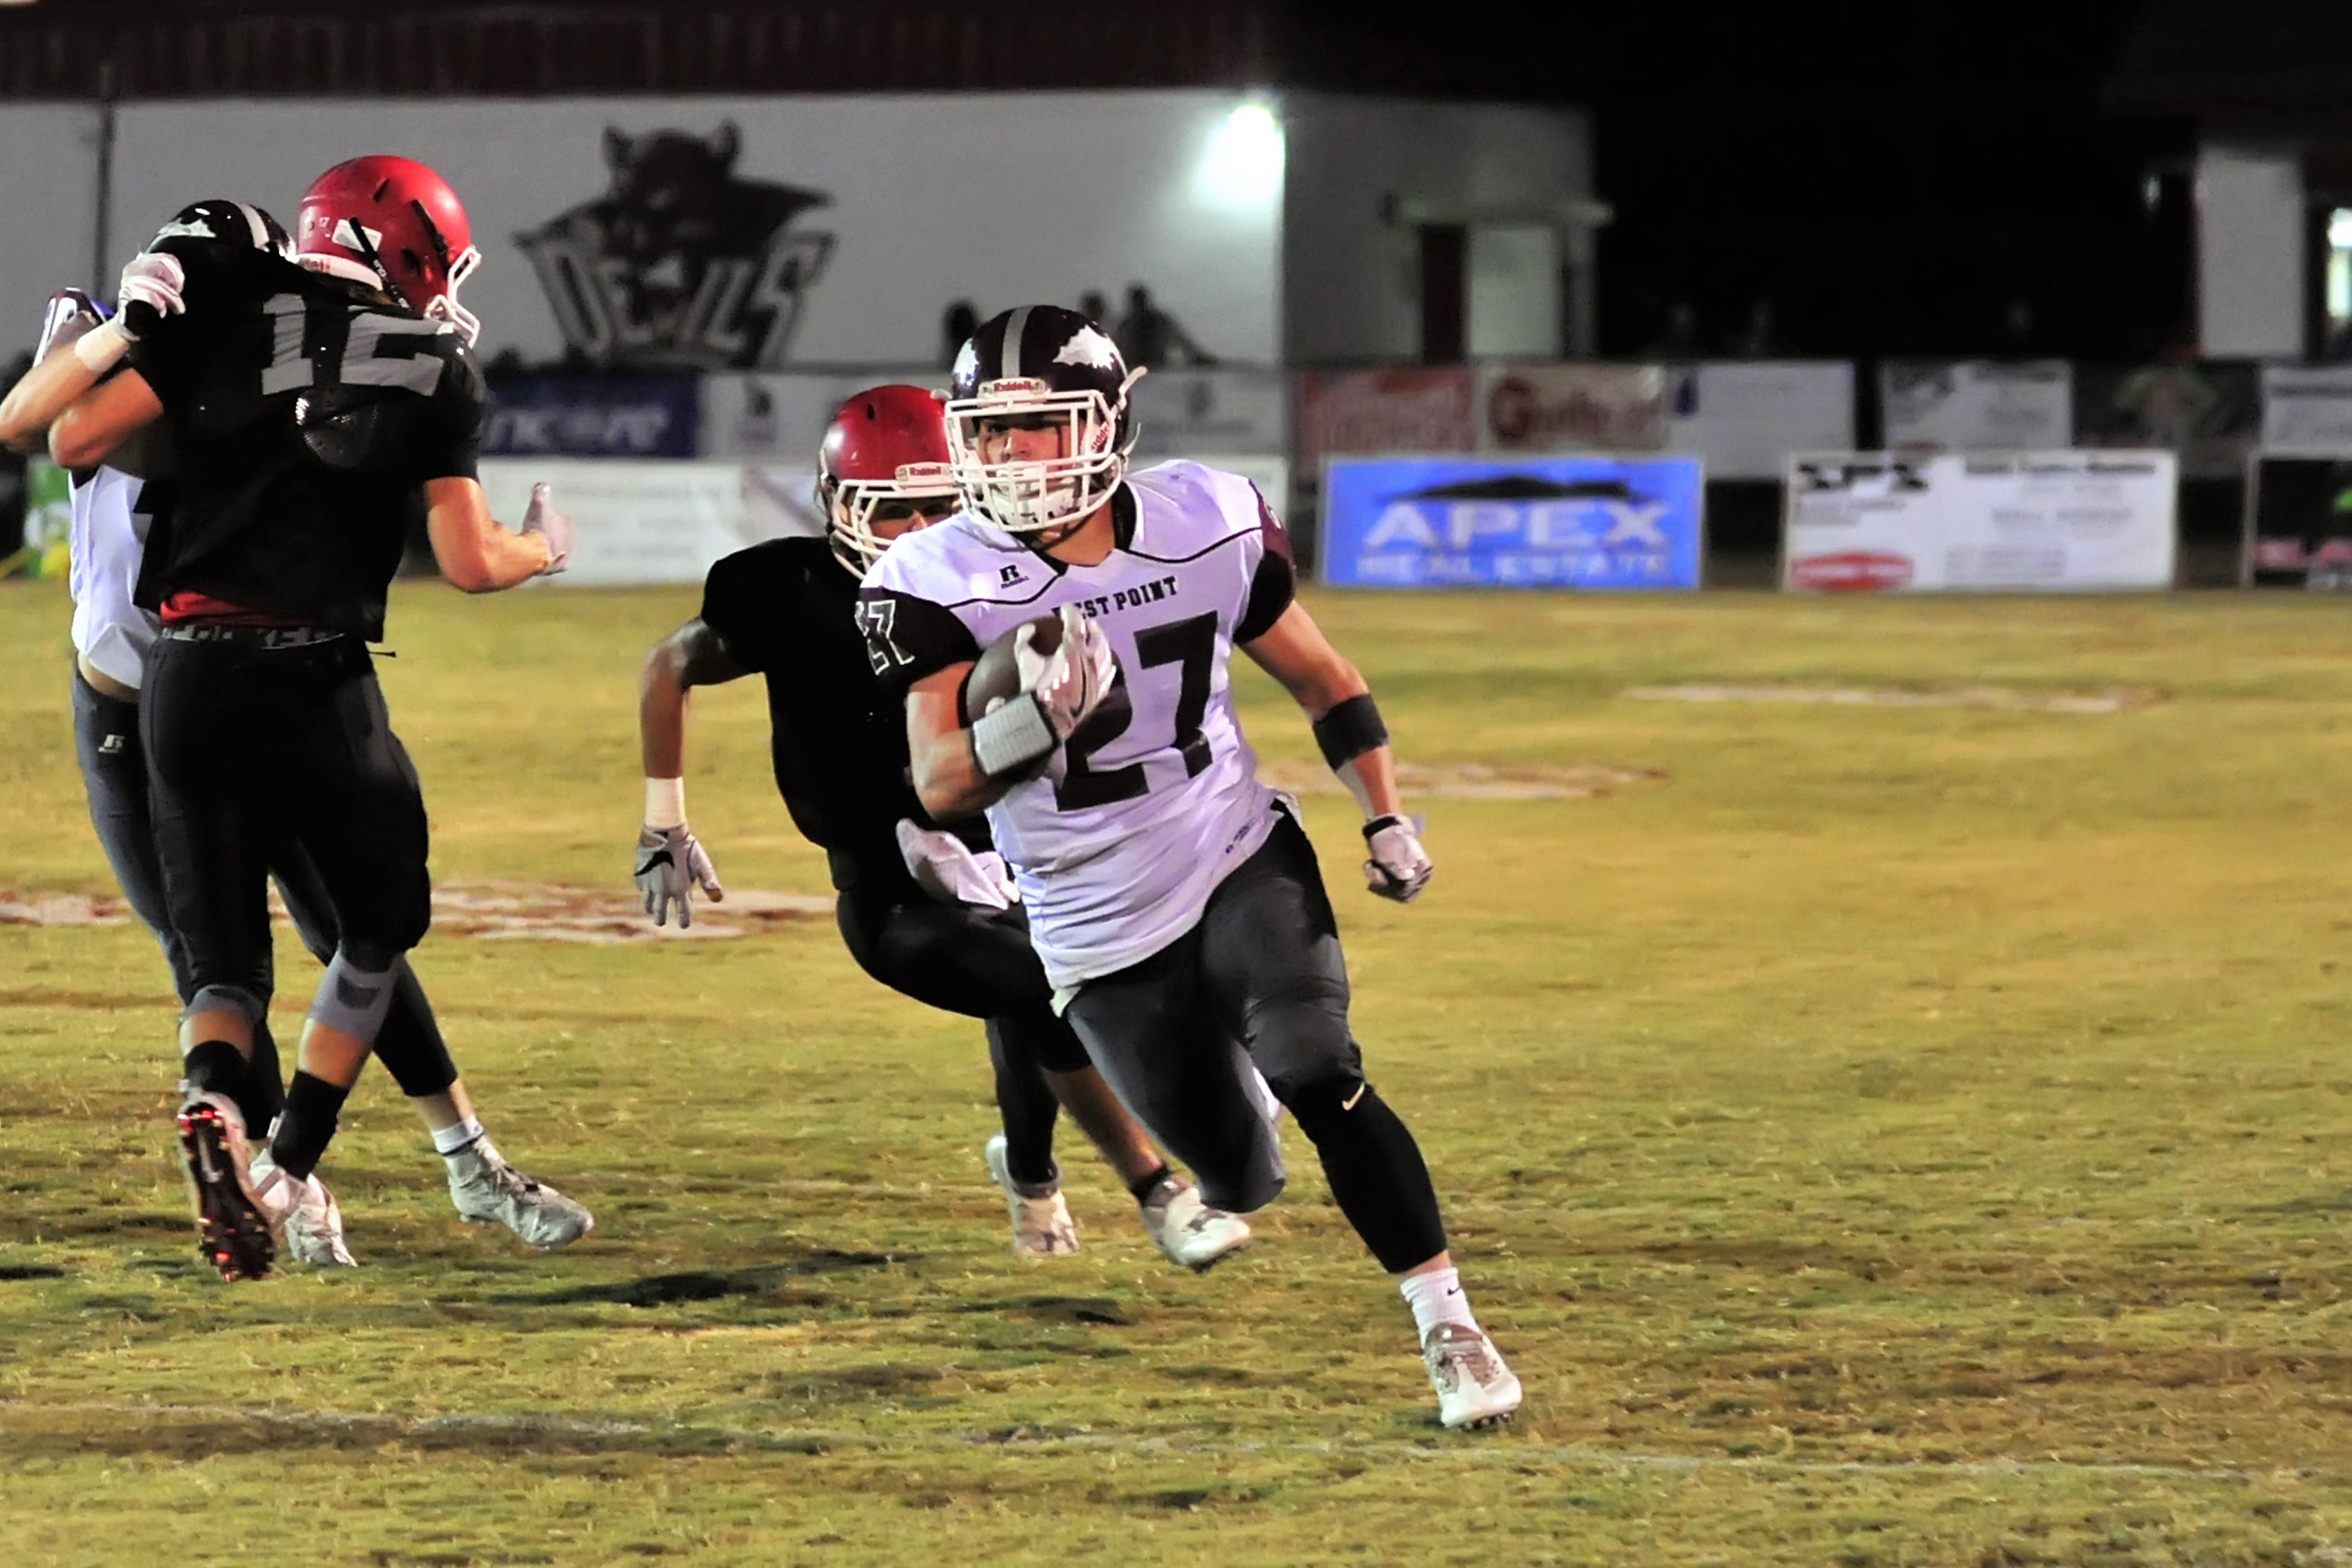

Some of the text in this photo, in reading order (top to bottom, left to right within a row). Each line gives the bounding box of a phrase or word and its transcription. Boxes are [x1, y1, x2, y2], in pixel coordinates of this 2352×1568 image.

[1363, 499, 1670, 550] APEX
[1112, 575, 1178, 611] POINT
[1058, 610, 1218, 811] 27
